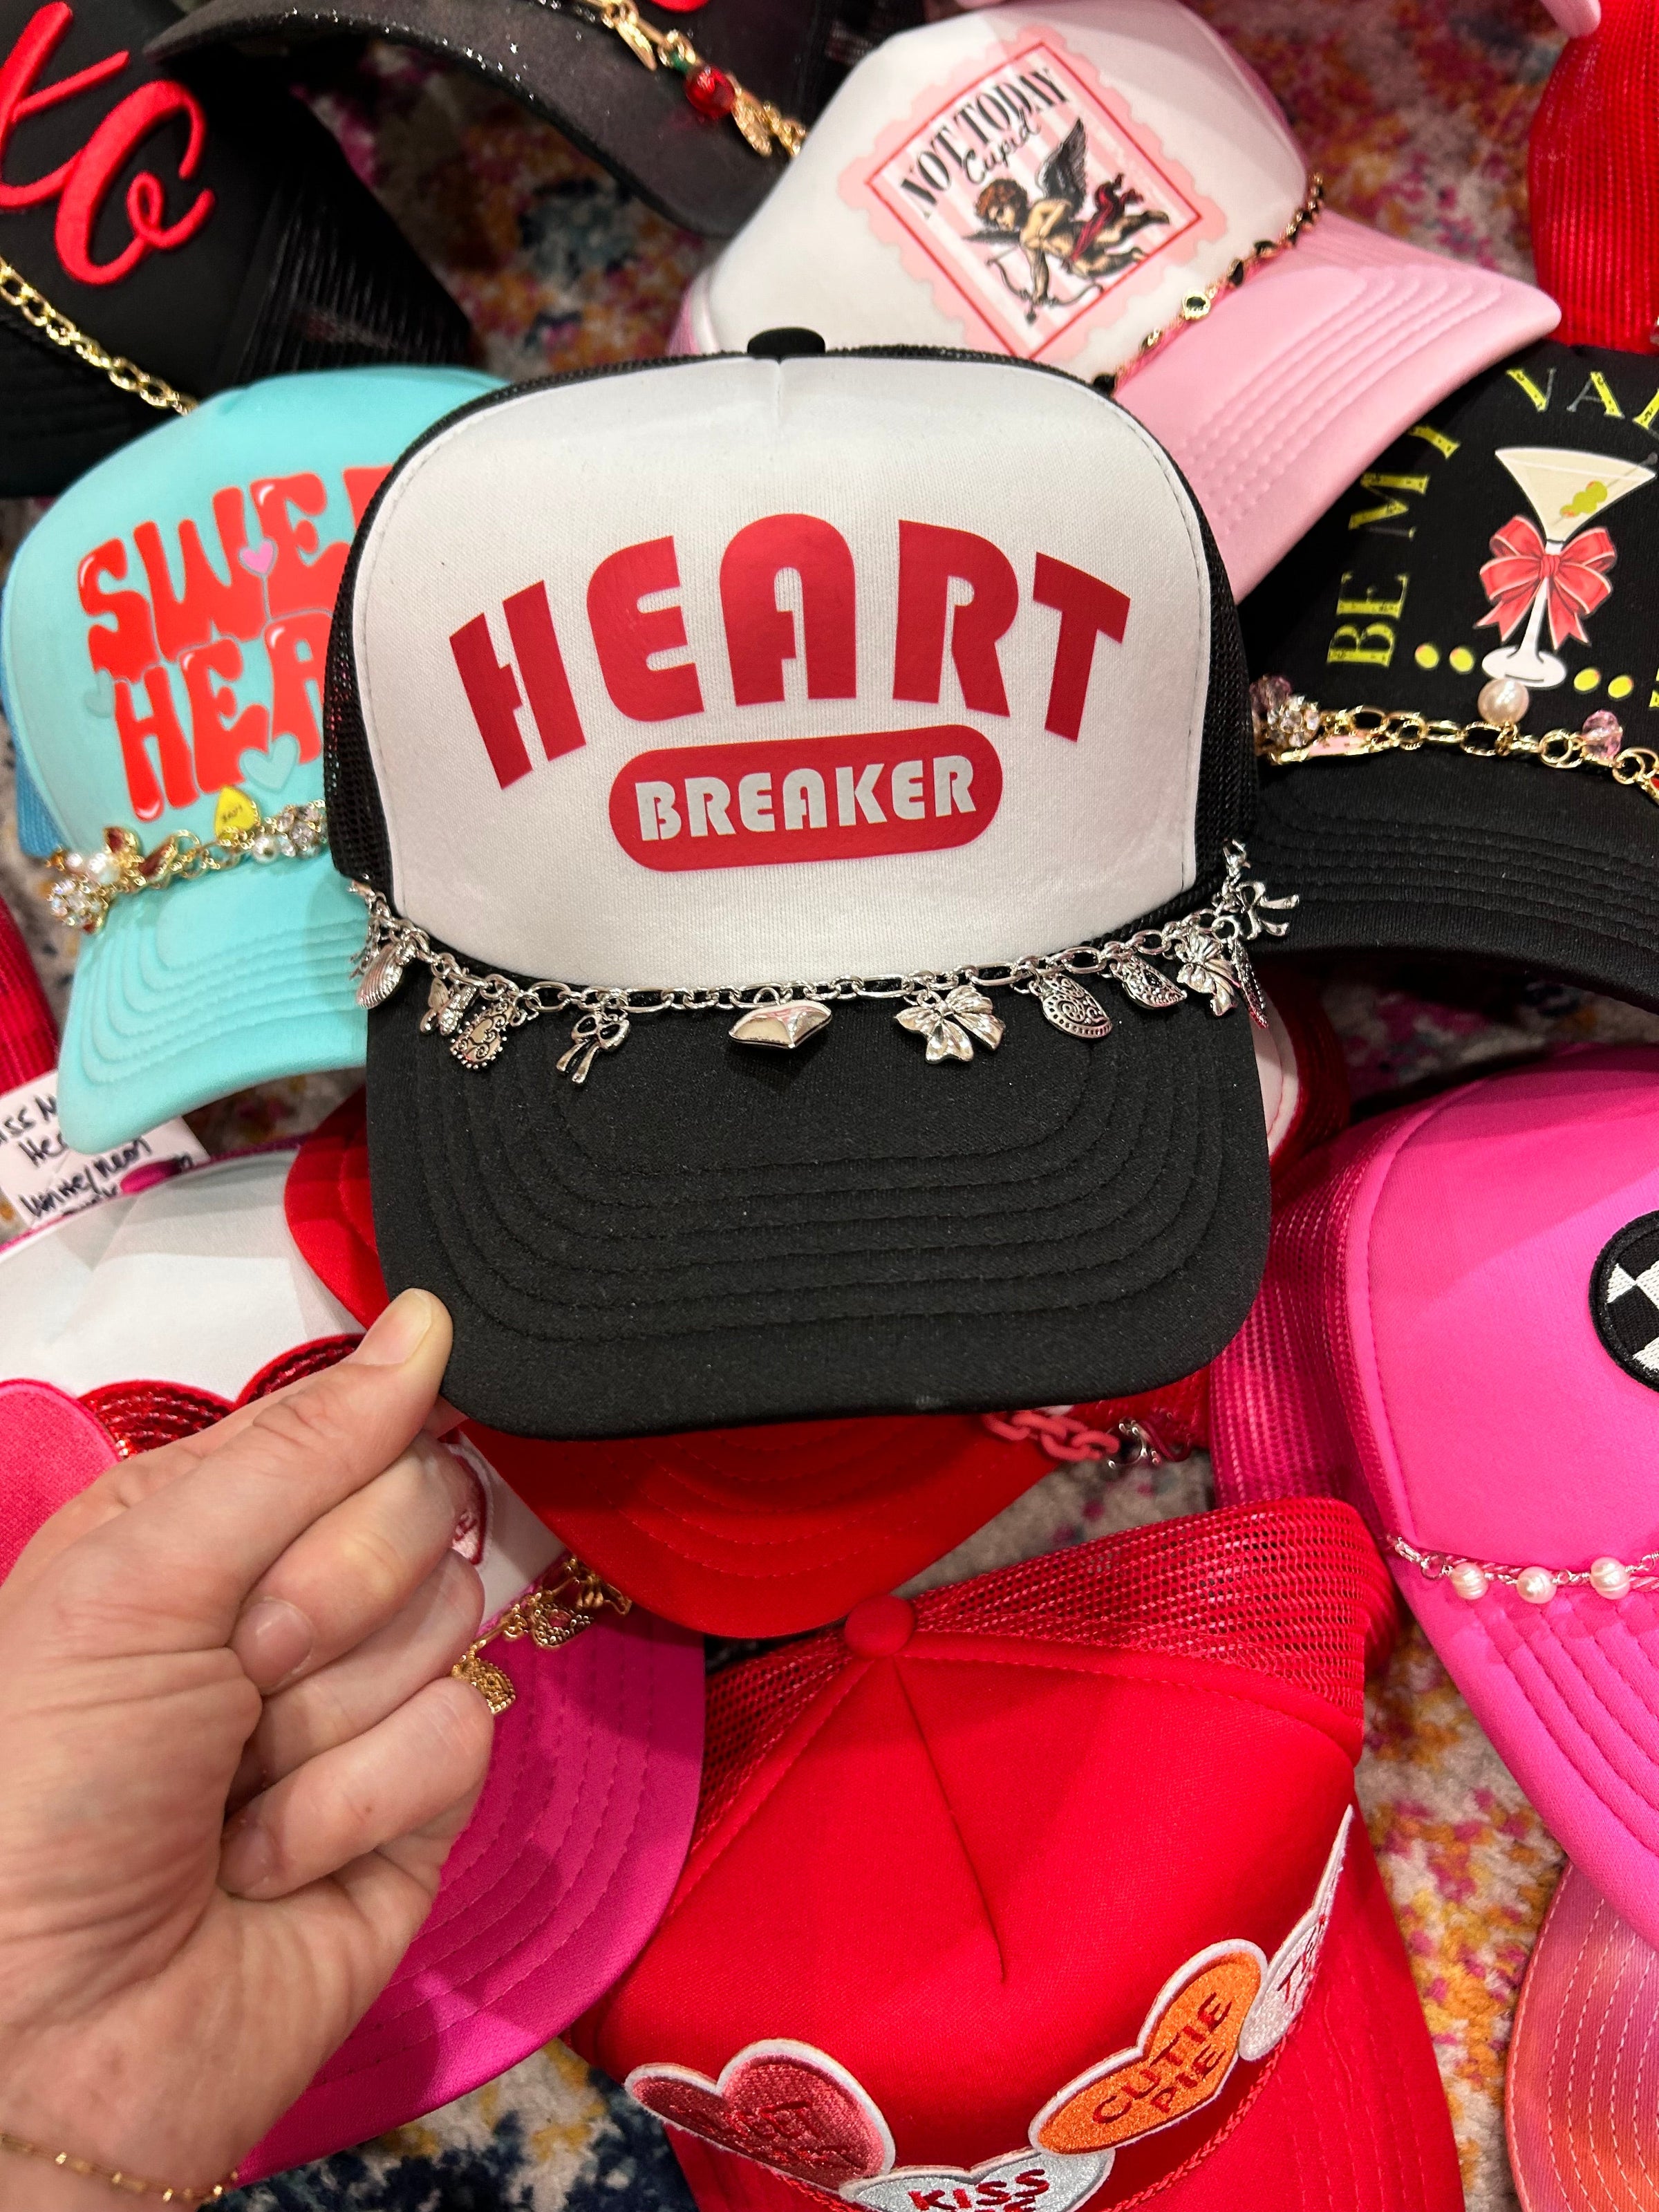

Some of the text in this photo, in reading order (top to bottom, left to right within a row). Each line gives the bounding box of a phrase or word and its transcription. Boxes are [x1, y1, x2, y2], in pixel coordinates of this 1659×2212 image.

[901, 67, 1071, 219] NOT TODAY
[963, 106, 1041, 185] Cupid
[1348, 424, 1461, 541] MY
[77, 465, 395, 683] SWE
[1327, 571, 1409, 668] BE
[449, 512, 1132, 791] HEART
[113, 610, 335, 823] HEA
[635, 754, 976, 842] BREAKER
[1092, 1992, 1232, 2124] CUTIE
[1150, 2044, 1226, 2114] PIE
[908, 2168, 1050, 2211] KISS
